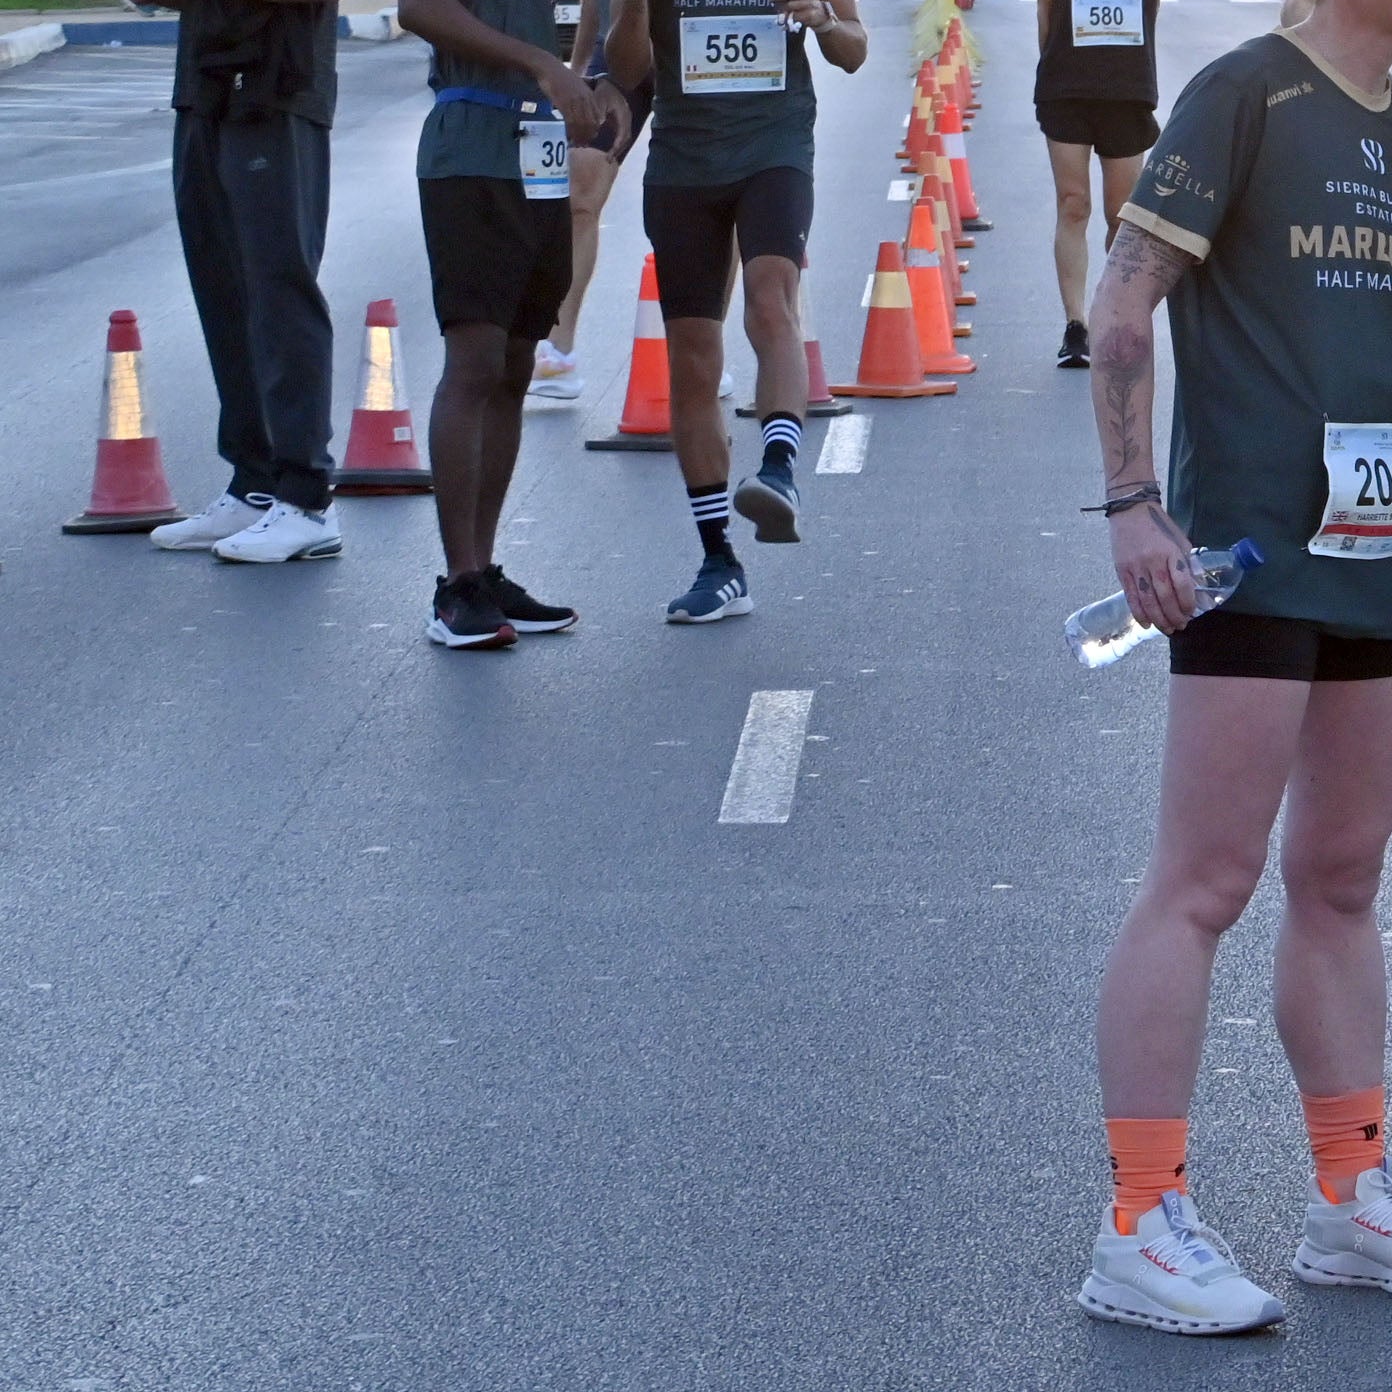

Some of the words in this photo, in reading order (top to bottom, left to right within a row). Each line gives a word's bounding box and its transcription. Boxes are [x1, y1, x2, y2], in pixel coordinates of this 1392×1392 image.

[1089, 5, 1124, 27] 580
[705, 33, 758, 64] 556
[1325, 180, 1377, 200] SIERRA
[1316, 269, 1363, 289] HALF
